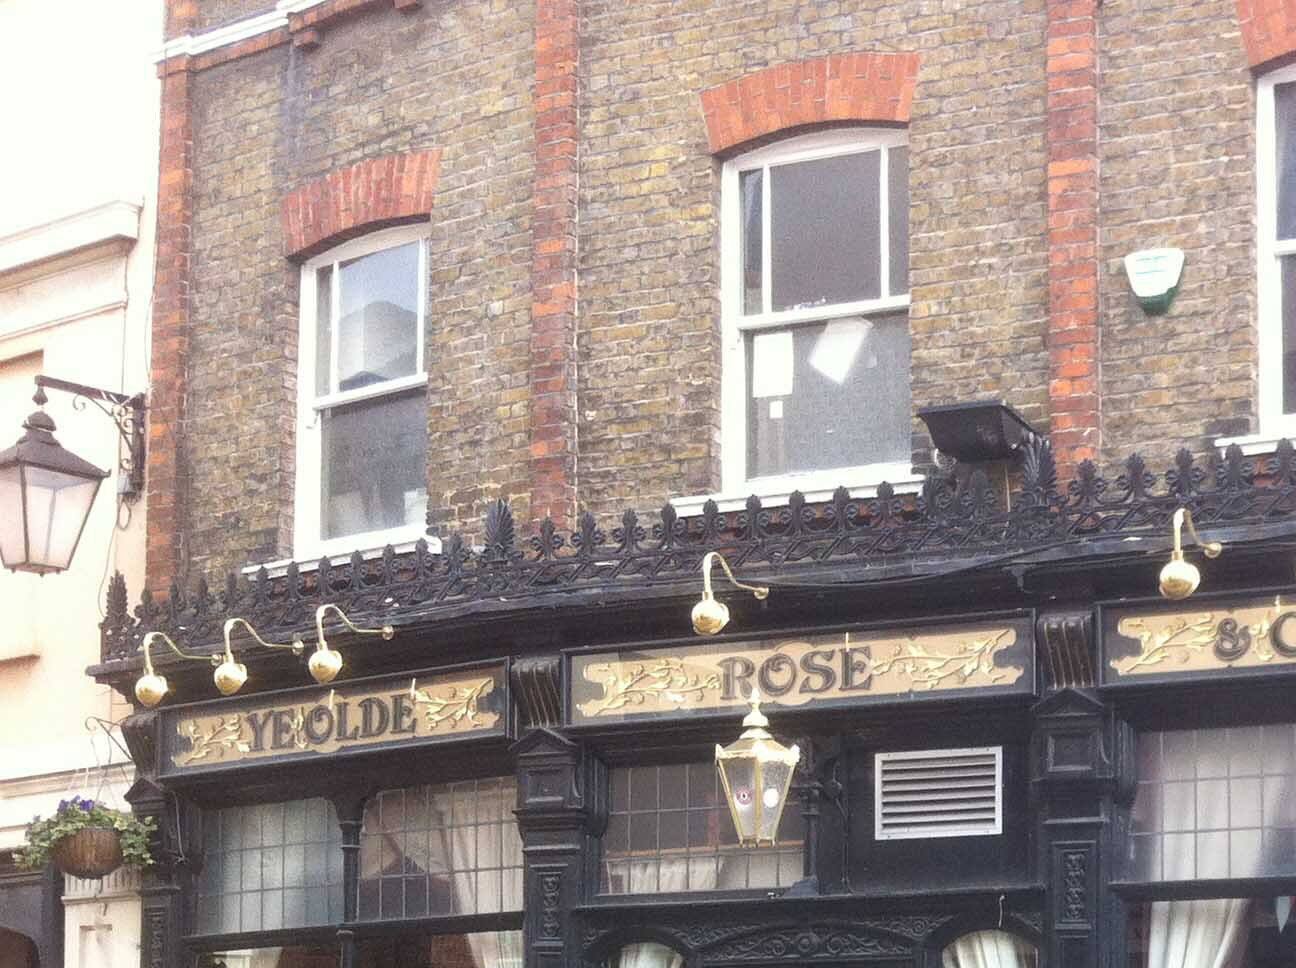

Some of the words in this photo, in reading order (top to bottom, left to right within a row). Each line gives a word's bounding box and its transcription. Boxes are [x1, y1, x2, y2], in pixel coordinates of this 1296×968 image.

[1213, 617, 1251, 660] &
[721, 647, 873, 701] ROSE
[246, 707, 297, 751] YE
[303, 692, 417, 745] OLDE
